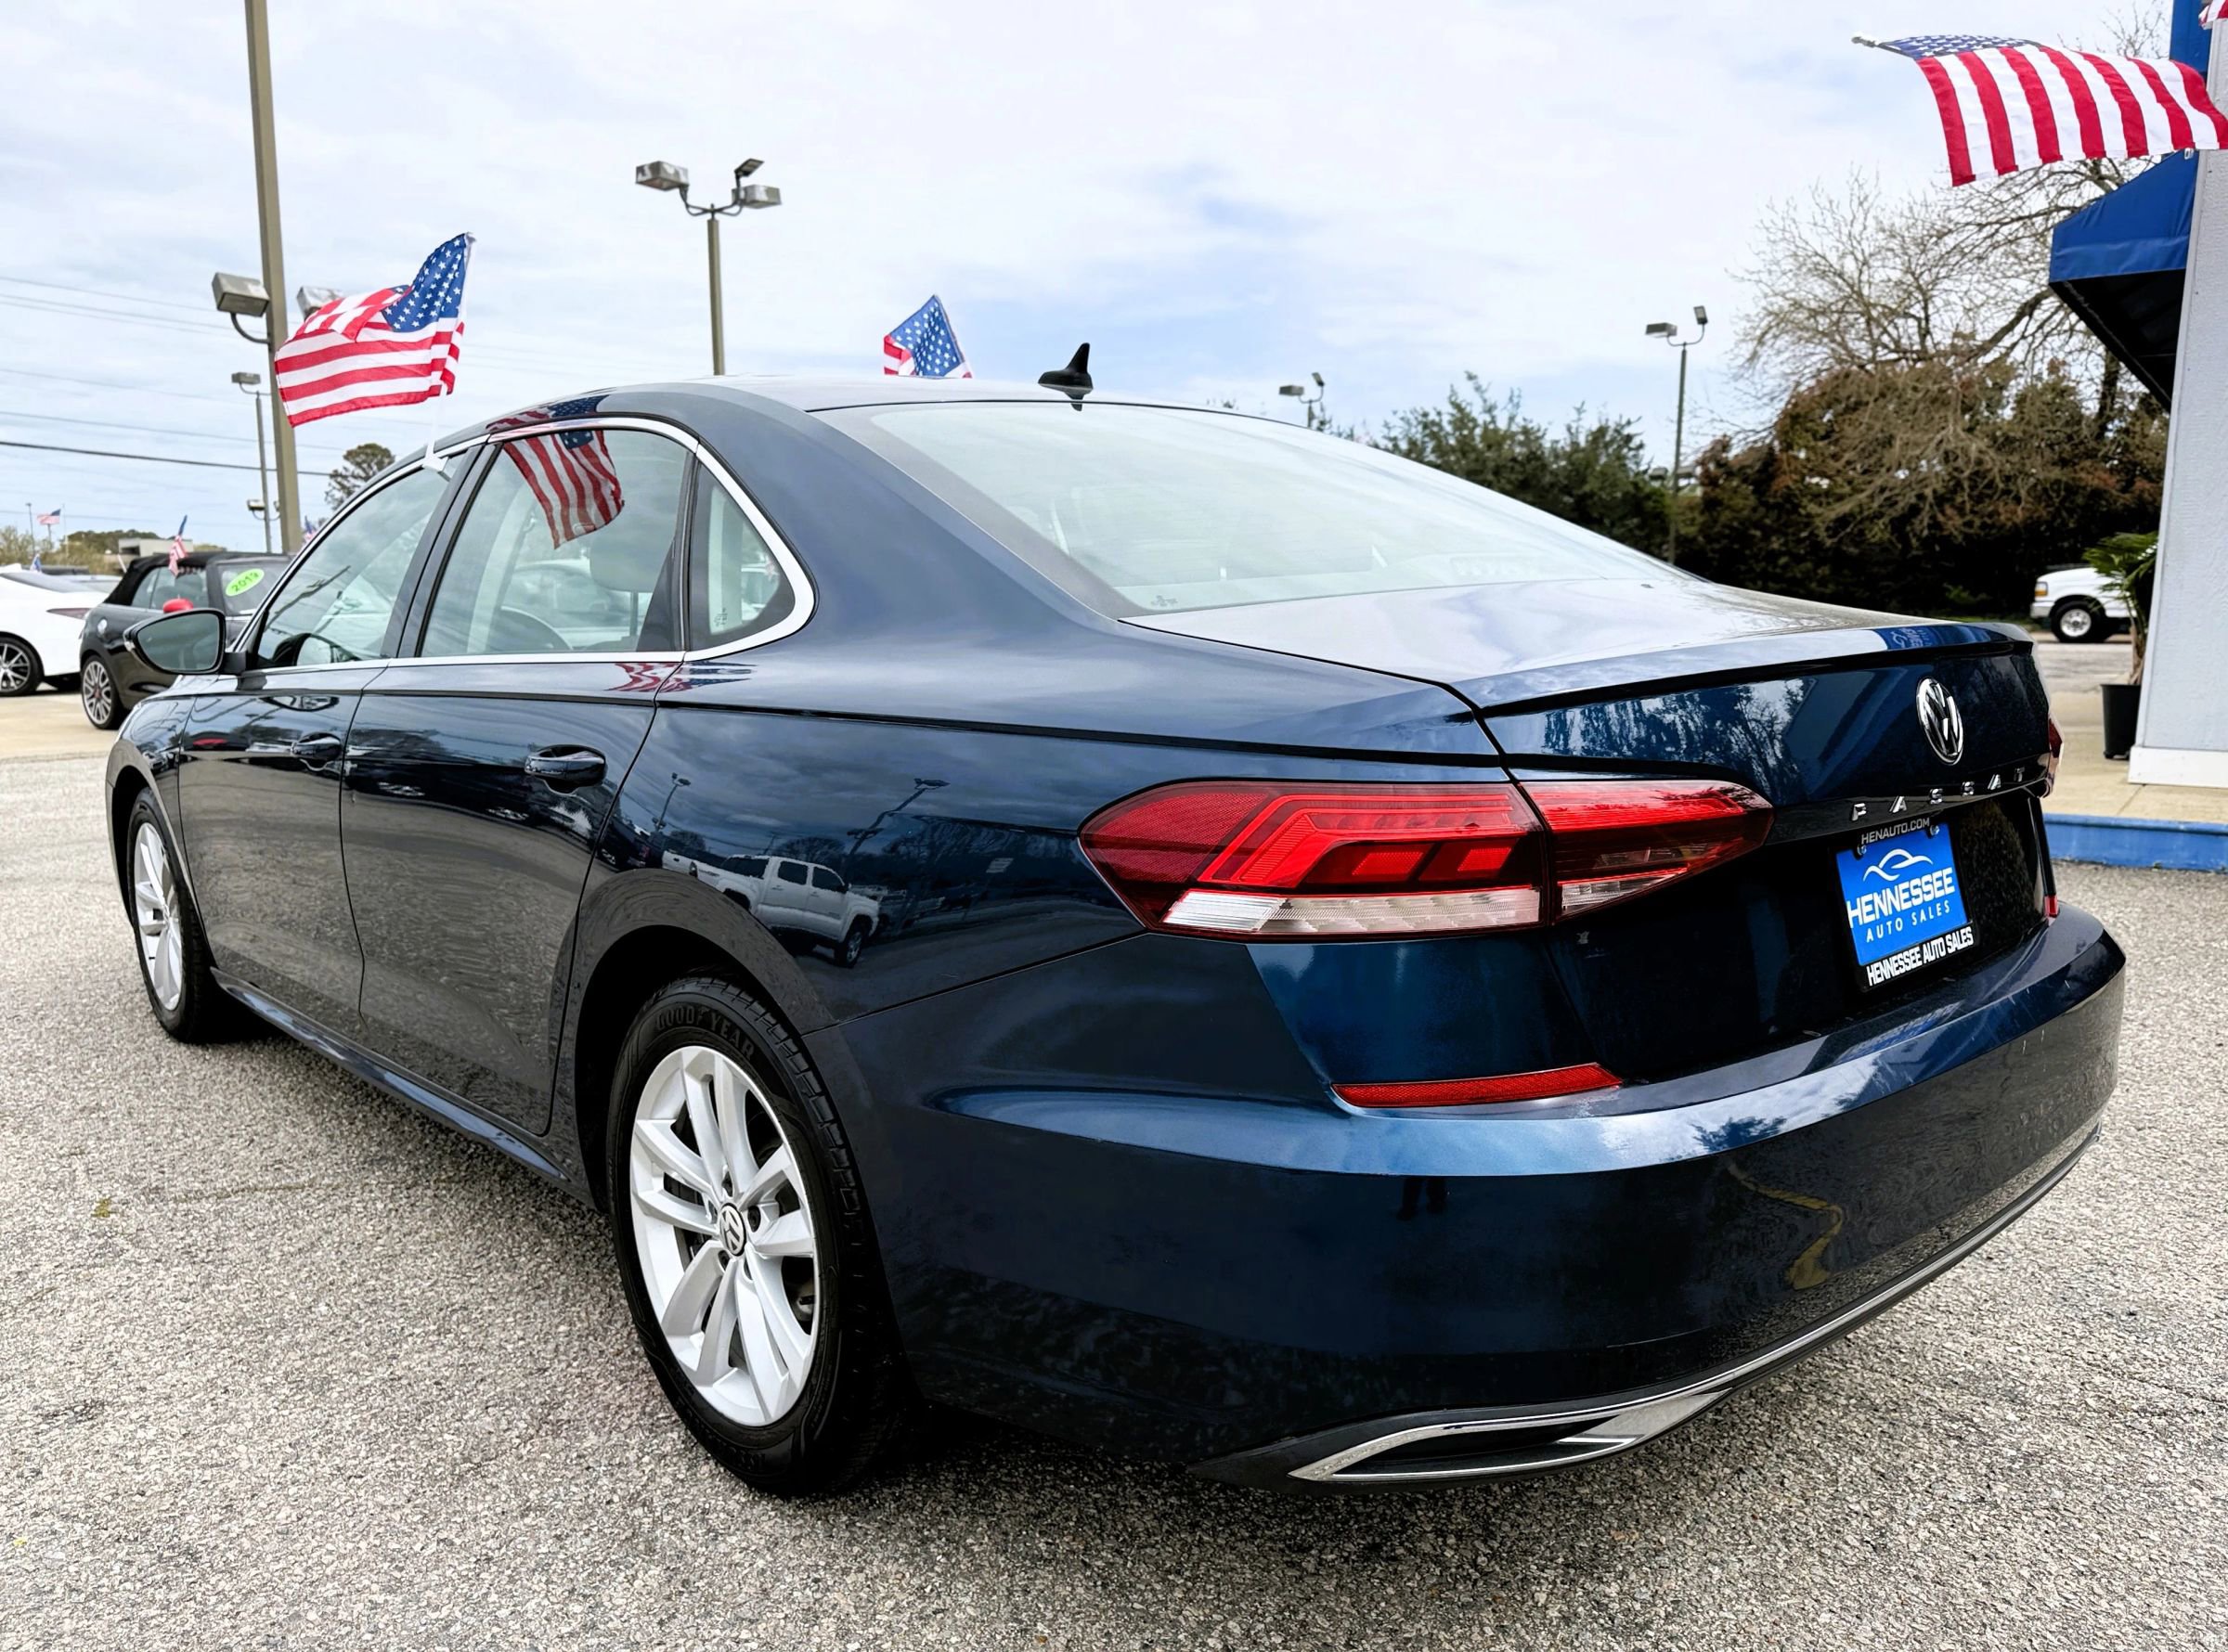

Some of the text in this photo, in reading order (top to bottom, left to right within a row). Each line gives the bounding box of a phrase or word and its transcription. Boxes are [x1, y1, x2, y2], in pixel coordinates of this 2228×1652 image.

[1851, 767, 2025, 821] PASSAT
[1860, 818, 1930, 845] HENAUTO.COM
[1846, 867, 1955, 928] HENNESSEE
[1866, 900, 1950, 943] AUTO SALES
[1866, 926, 1974, 987] HENNESSEE AUTO SALES
